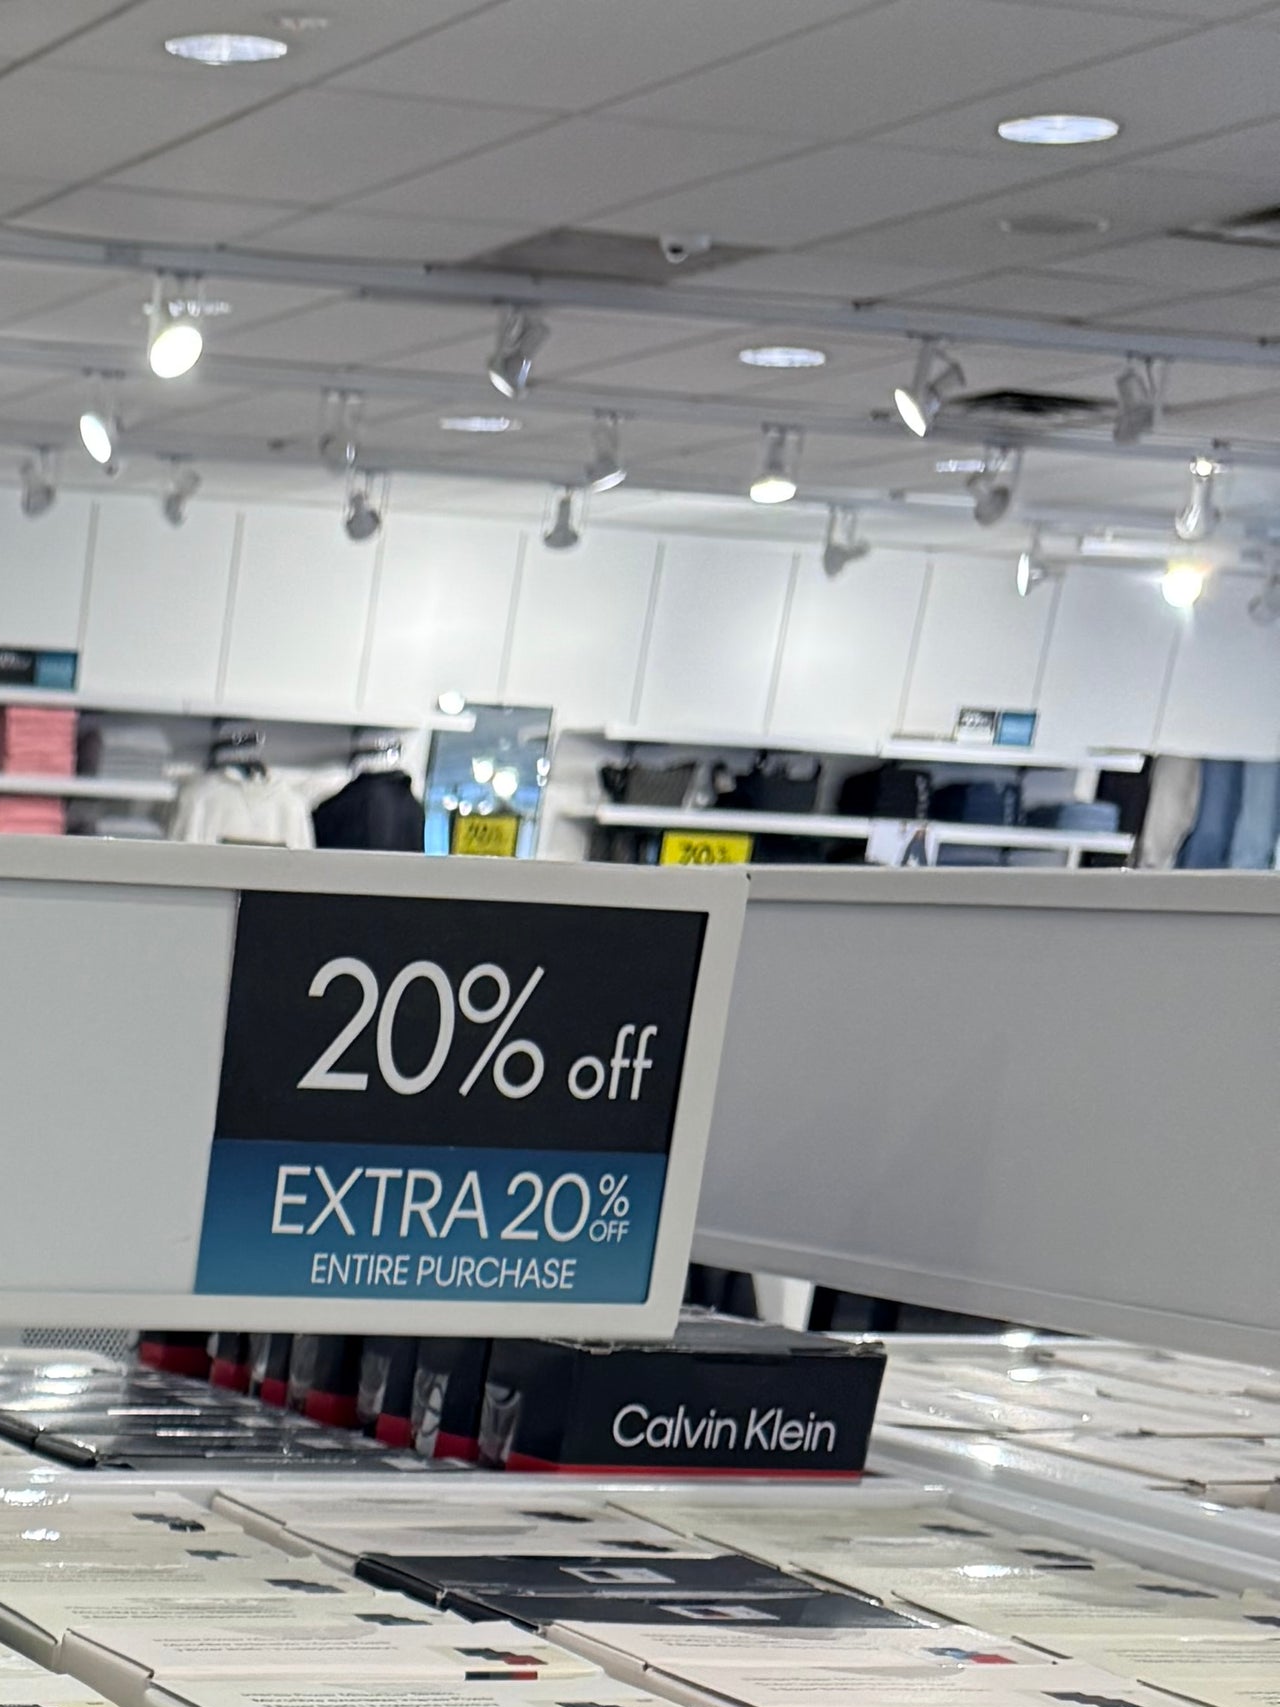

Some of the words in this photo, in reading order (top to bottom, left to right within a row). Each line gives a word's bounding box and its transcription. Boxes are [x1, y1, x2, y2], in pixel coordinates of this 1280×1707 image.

[297, 957, 544, 1098] 20%
[568, 1024, 657, 1100] off
[272, 1165, 488, 1239] EXTRA
[588, 1218, 630, 1243] OFF
[310, 1252, 411, 1286] ENTIRE
[416, 1254, 577, 1289] PURCHASE
[613, 1404, 737, 1449] Calvin
[744, 1407, 836, 1452] Klein
